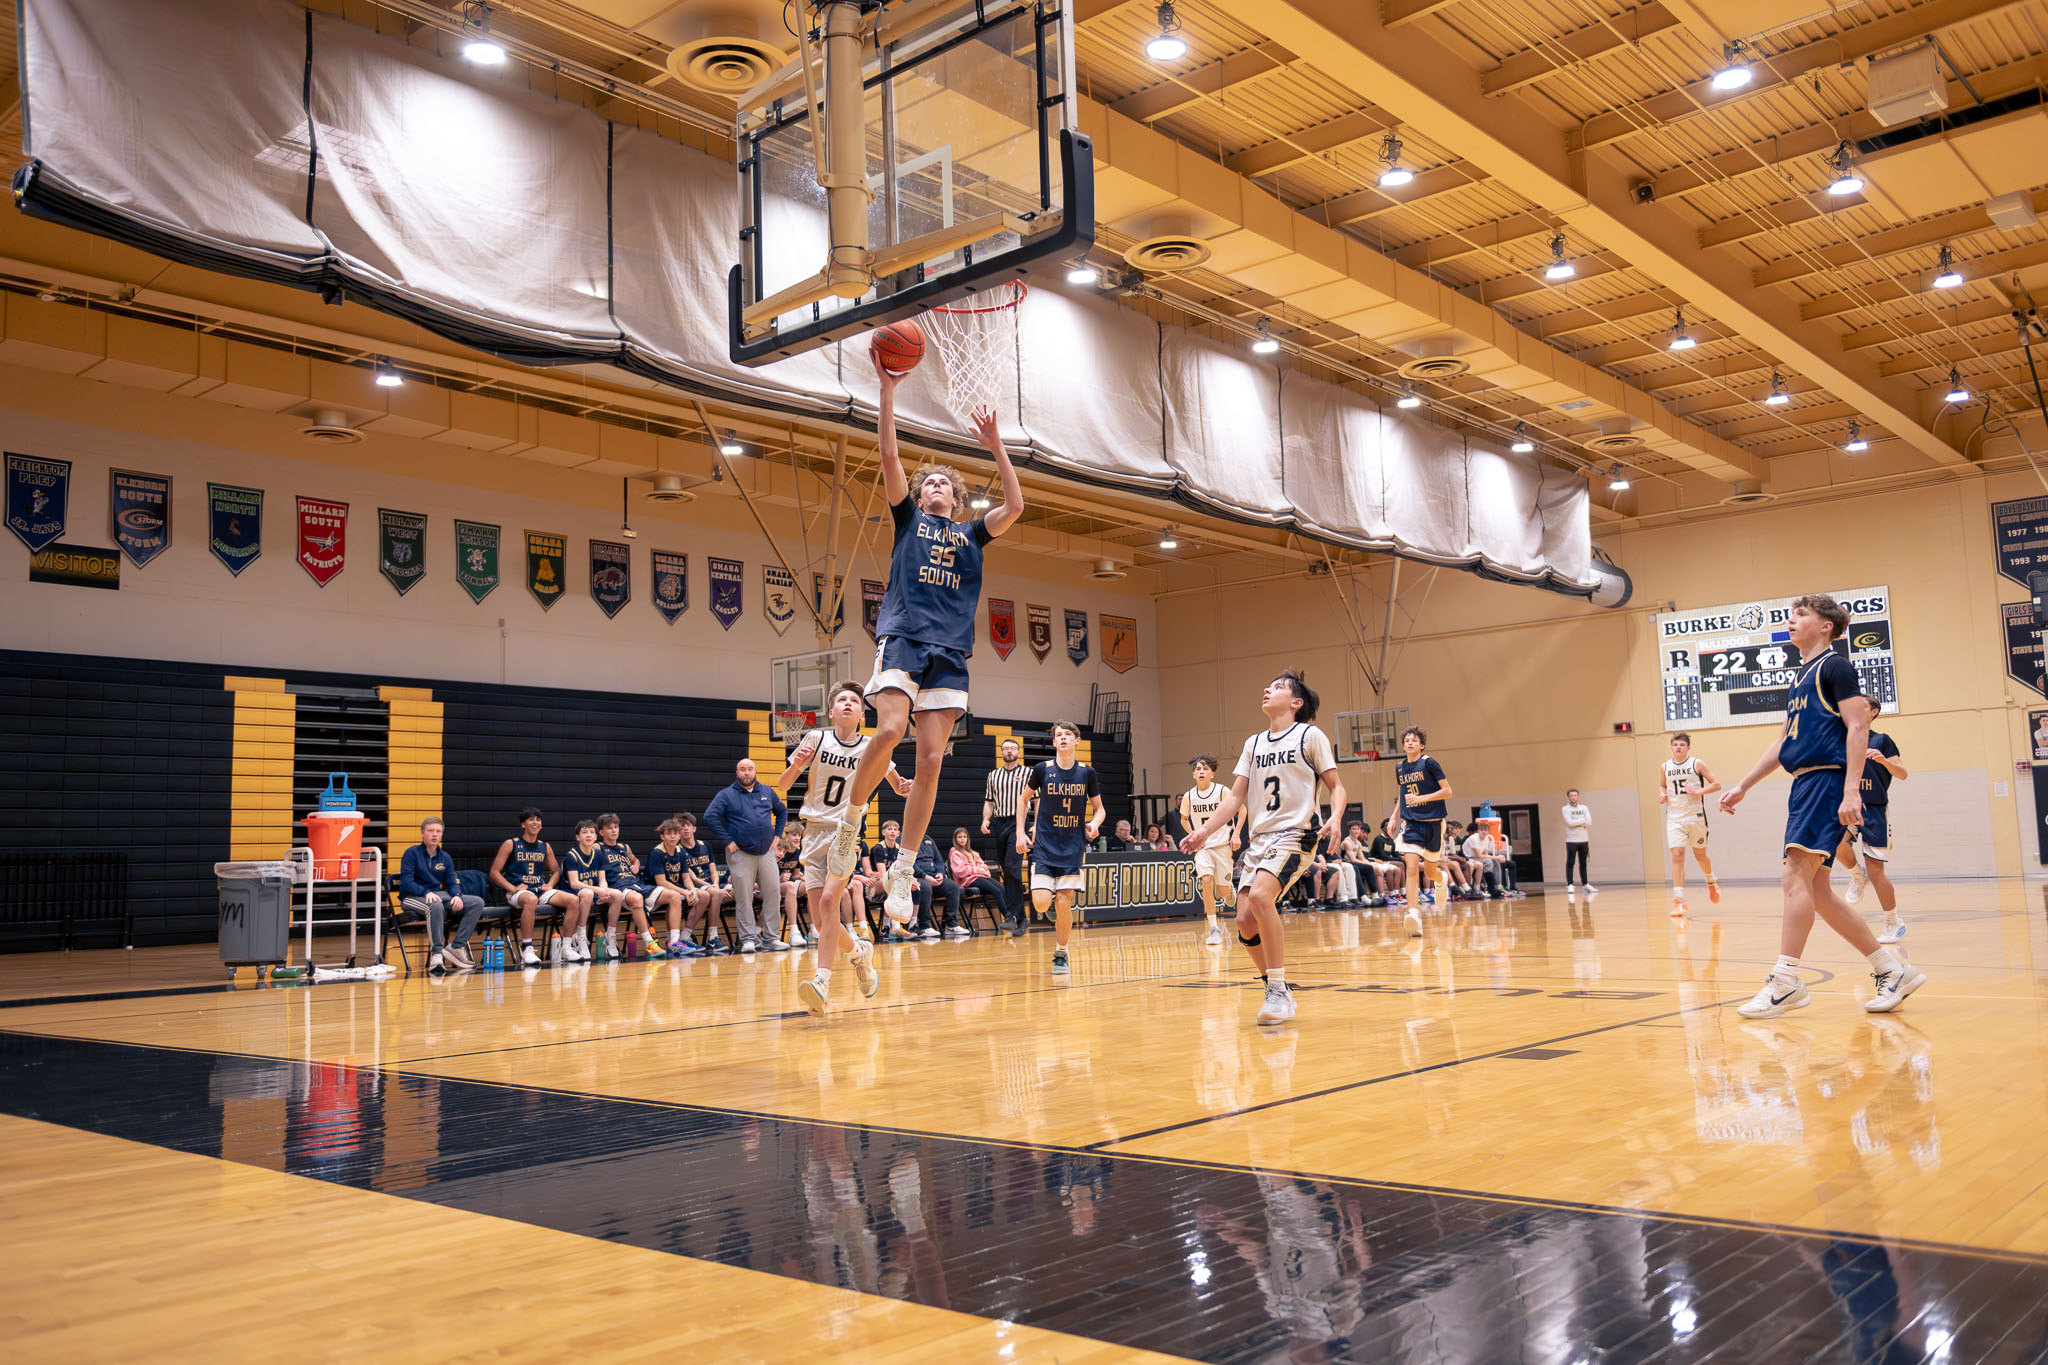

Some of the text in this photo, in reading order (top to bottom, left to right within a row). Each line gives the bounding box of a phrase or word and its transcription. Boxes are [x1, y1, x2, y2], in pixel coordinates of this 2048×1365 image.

[9, 460, 66, 477] CREIGHTON
[19, 472, 56, 487] PREP
[116, 477, 166, 492] ELKHORN
[120, 489, 163, 504] SOUTH
[212, 489, 260, 505] MILLARD
[215, 502, 256, 516] NORTH
[300, 504, 345, 518] MILLARD
[32, 521, 61, 534] JAYS
[138, 516, 163, 526] STORM
[305, 515, 341, 528] SOUTH
[119, 532, 160, 548] STORM
[387, 527, 417, 540] WEST
[2007, 528, 2027, 537] 1977
[303, 552, 343, 569] PATRIOTS
[929, 544, 956, 568] 35
[2010, 556, 2030, 566] 1993
[36, 552, 118, 577] VISITOR
[712, 562, 740, 573] OMAHA
[711, 571, 742, 582] CENTRAL
[765, 577, 793, 588] MARIAN
[918, 565, 961, 590] SOUTH
[715, 603, 739, 615] EAGLES
[2007, 605, 2027, 617] GIRLS
[1664, 615, 1731, 636] BURKE
[1712, 652, 1747, 676] 22
[1768, 654, 1777, 667] 4
[1751, 669, 1796, 687] 05:09
[1709, 682, 1718, 692] 2
[820, 750, 861, 771] BURK
[1255, 749, 1297, 769] BURKE
[1399, 770, 1425, 785] ELKHORN
[1667, 767, 1692, 777] BURKE
[823, 775, 846, 807] 0
[1047, 782, 1086, 797] ELKHORN
[1263, 775, 1280, 811] 3
[1062, 798, 1072, 813] 4
[1053, 815, 1080, 828] SOUTH
[517, 851, 545, 862] ELKHORN
[527, 862, 535, 875] 3
[1121, 862, 1194, 904] BULLDOGS
